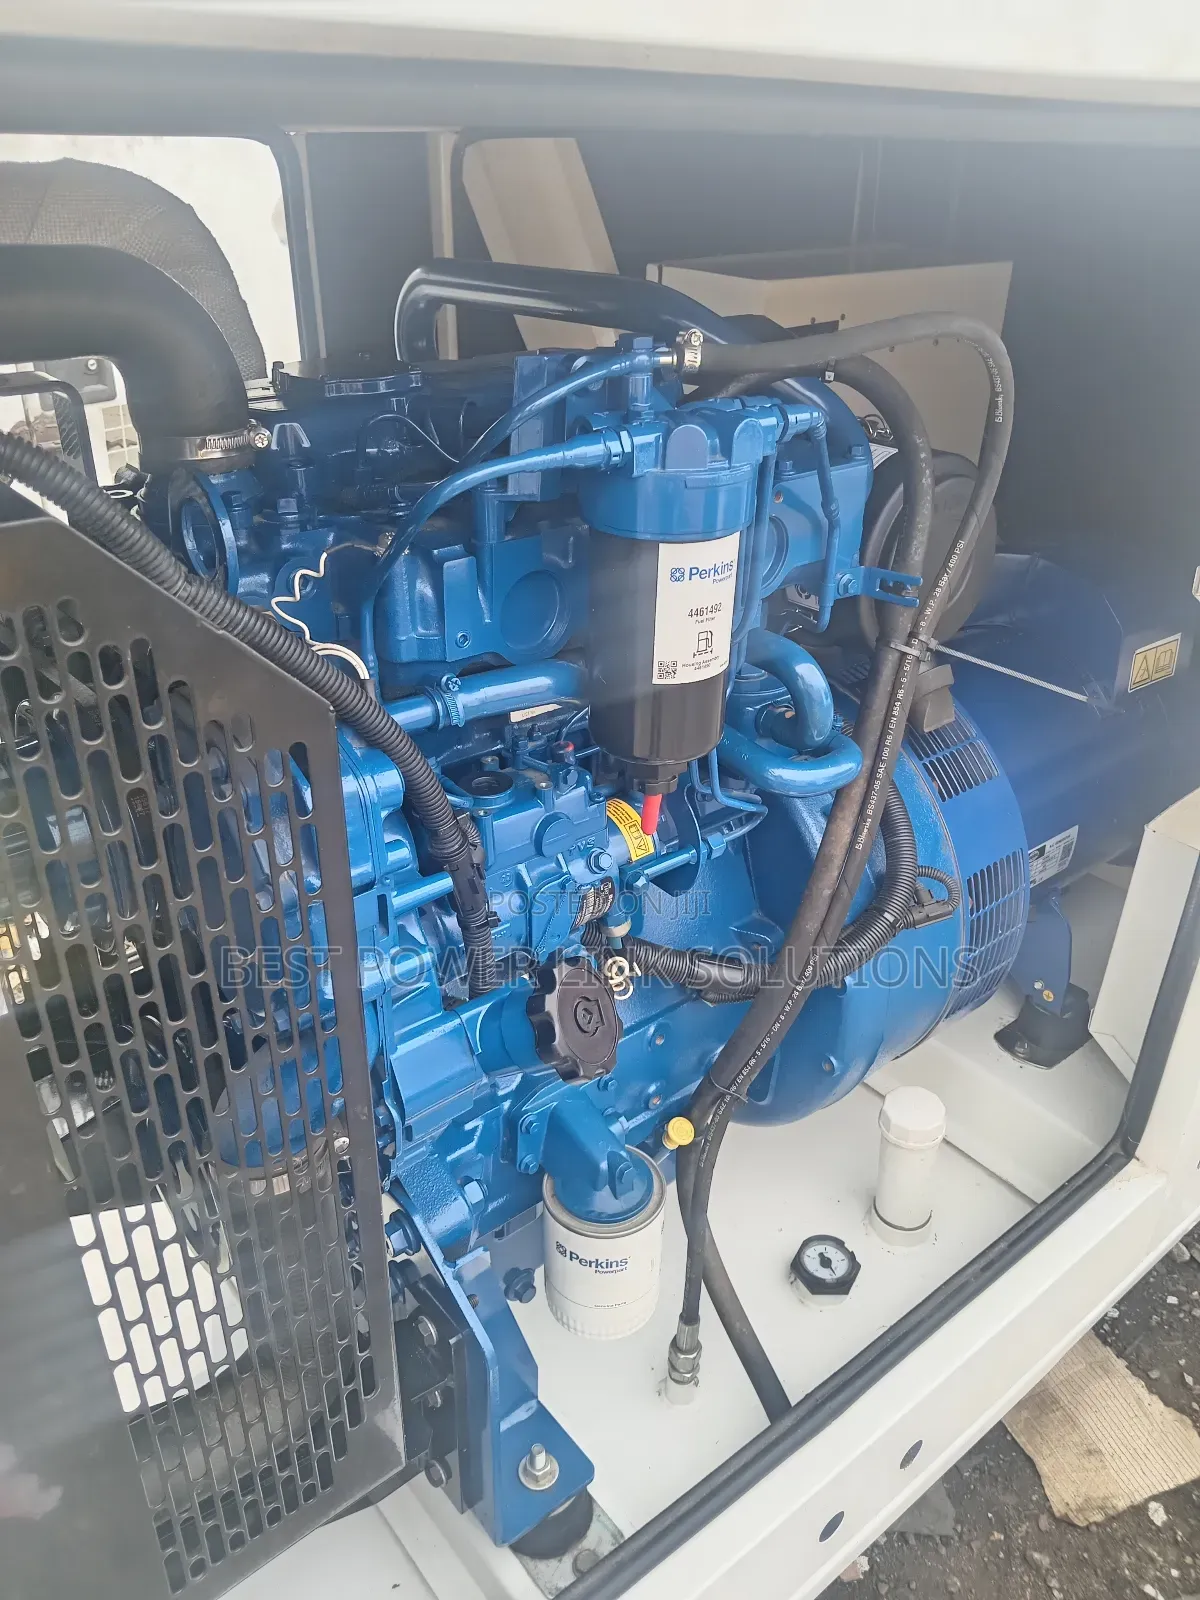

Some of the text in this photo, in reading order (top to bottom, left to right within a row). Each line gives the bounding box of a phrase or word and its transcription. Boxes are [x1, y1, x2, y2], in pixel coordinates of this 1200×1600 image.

[954, 539, 965, 554] PSI
[948, 554, 958, 569] 400
[688, 559, 734, 581] Perkins
[938, 572, 950, 587] Bar
[933, 587, 942, 599] 28
[687, 602, 722, 618] 4461492
[904, 653, 914, 671] 5/16
[892, 700, 902, 716] 854
[888, 717, 897, 730] EN
[881, 746, 890, 762] 100
[878, 761, 887, 779] SAE
[736, 1071, 745, 1083] EN
[569, 1250, 629, 1270] Perkins
[594, 1266, 628, 1275] Powerpart
